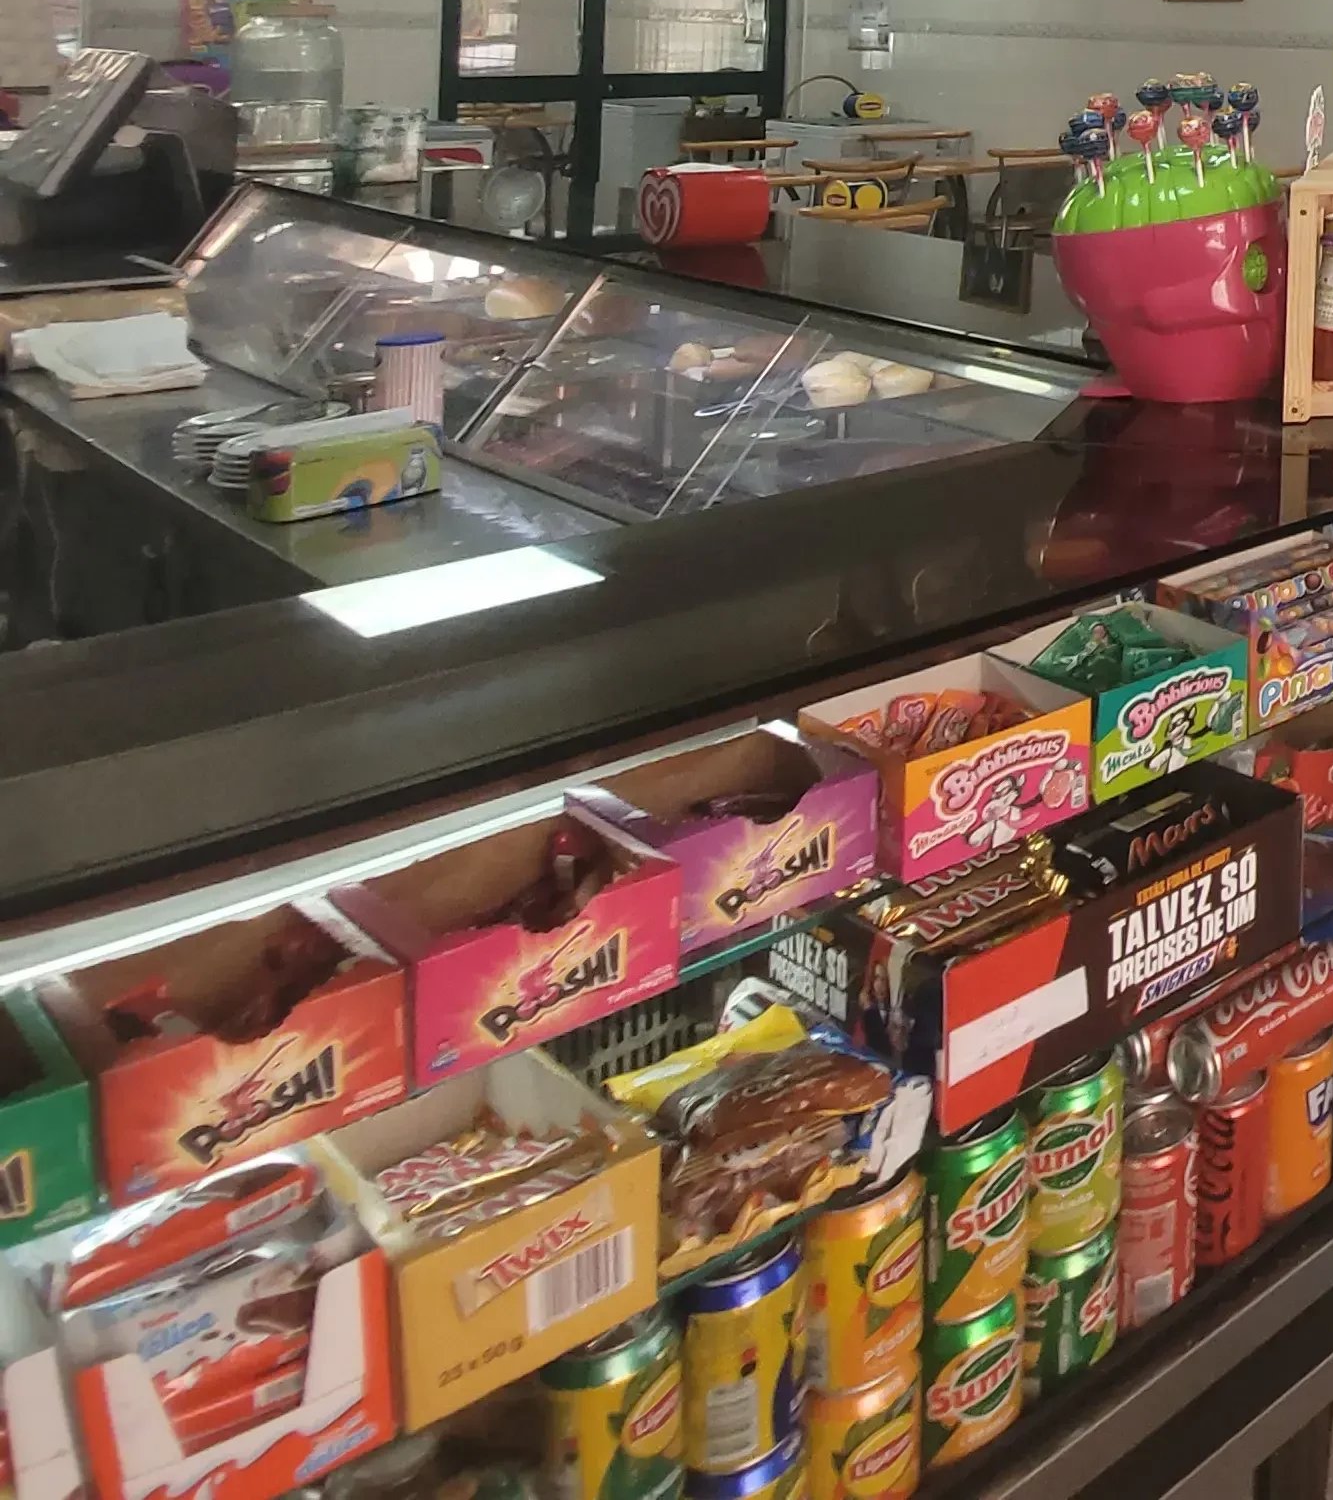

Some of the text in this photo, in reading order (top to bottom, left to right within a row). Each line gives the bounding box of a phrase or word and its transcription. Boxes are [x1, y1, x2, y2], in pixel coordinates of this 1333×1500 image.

[1127, 672, 1227, 740] Bubblicious
[939, 734, 1064, 810] Bubblicious
[1127, 802, 1217, 873] Mars
[886, 873, 1031, 941] TWIX
[1107, 845, 1258, 963] TALVEZ SÓ
[1106, 888, 1257, 1001] PRECISES DE UM
[1142, 951, 1214, 1007] SNICKERS
[1031, 1106, 1115, 1176] umol
[949, 1172, 1029, 1246] Sum
[479, 1209, 594, 1289] TWIX
[927, 1347, 1022, 1416] Sum
